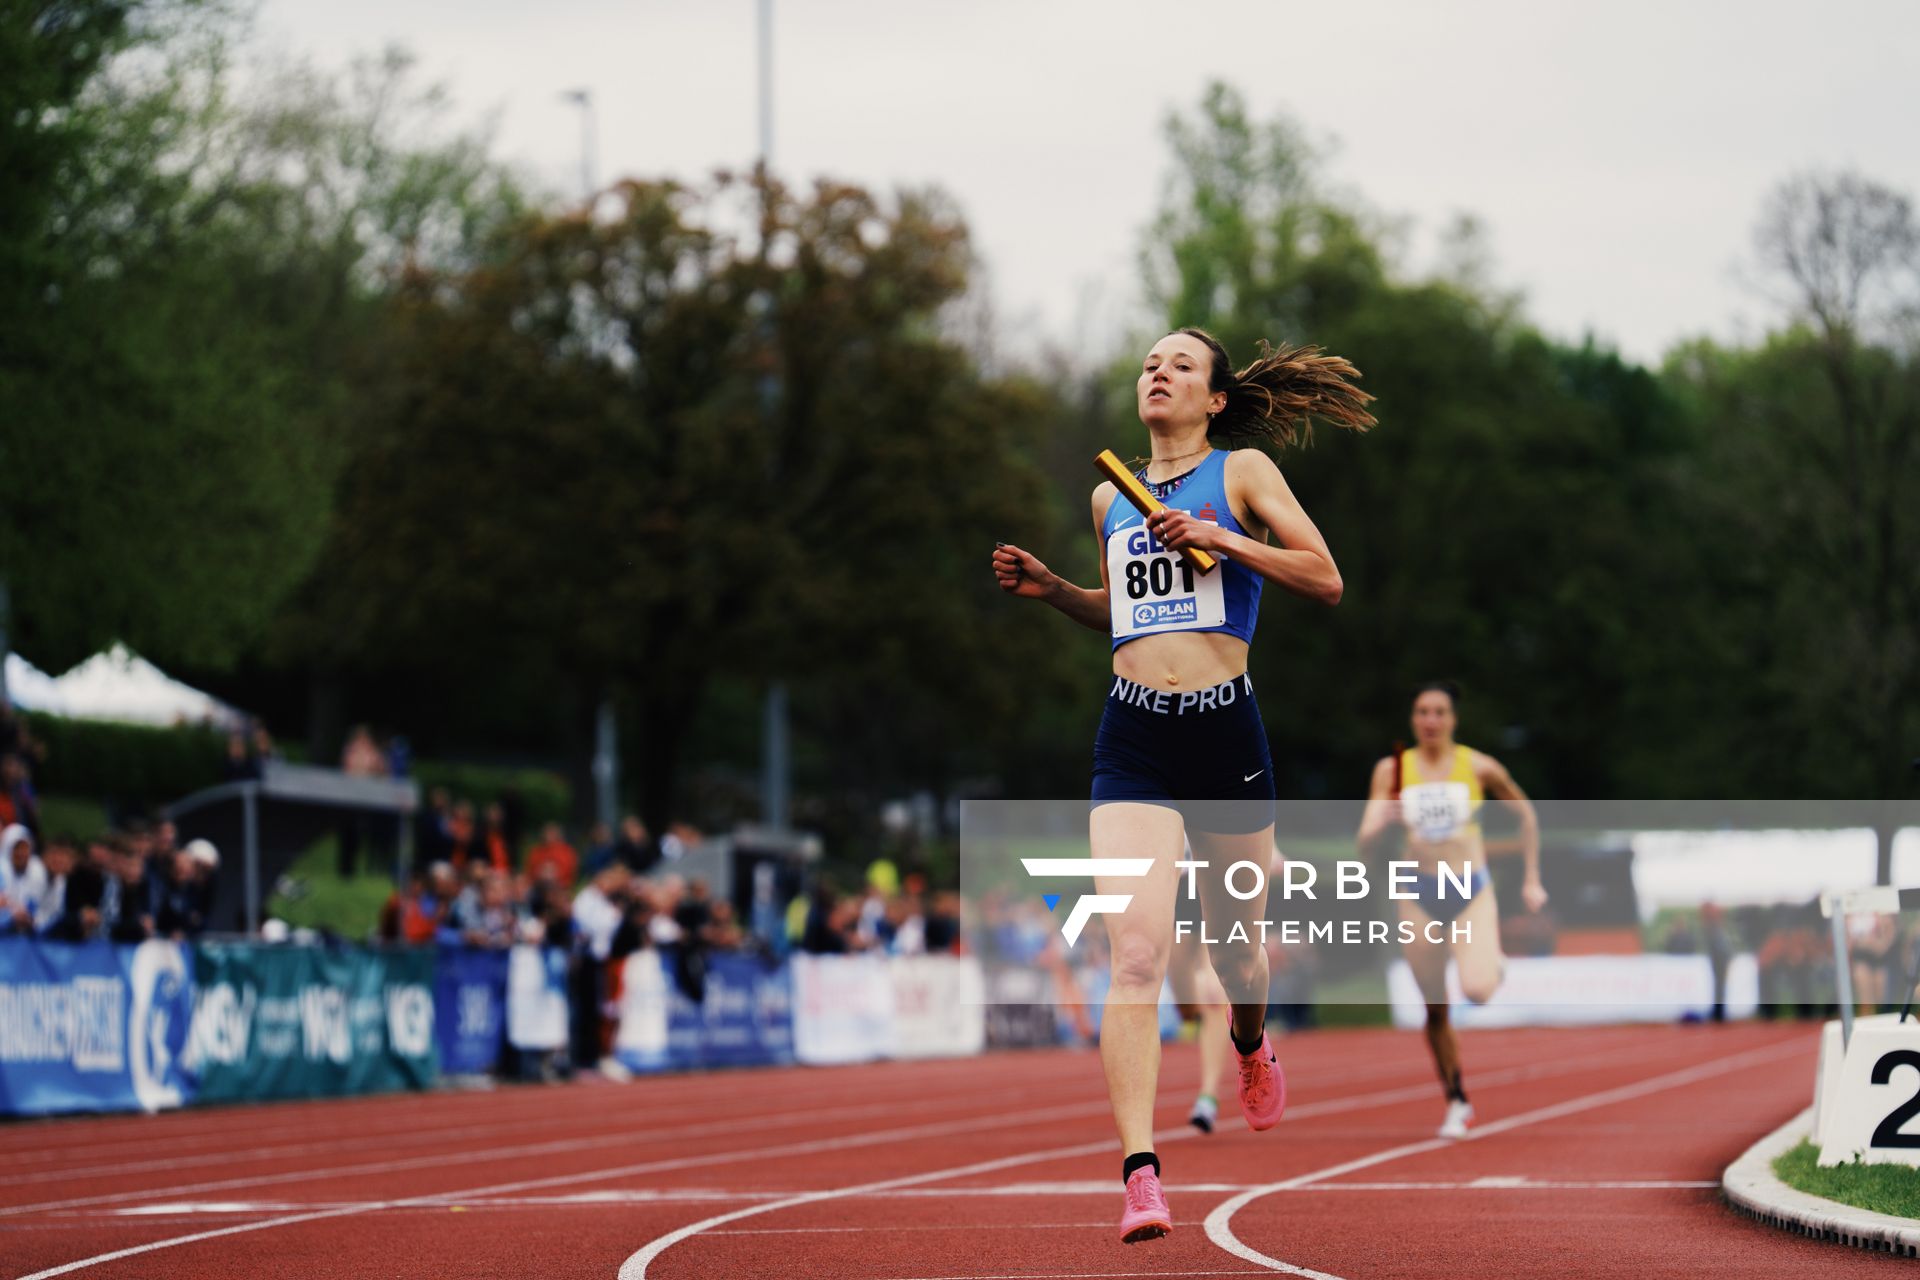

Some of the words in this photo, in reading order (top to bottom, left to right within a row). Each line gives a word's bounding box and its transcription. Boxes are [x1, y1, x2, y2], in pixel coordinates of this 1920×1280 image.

[1125, 557, 1195, 600] 801
[1158, 602, 1194, 616] PLAN
[1110, 676, 1172, 715] NIKE
[1177, 681, 1236, 715] PRO
[1870, 1049, 1920, 1149] 2
